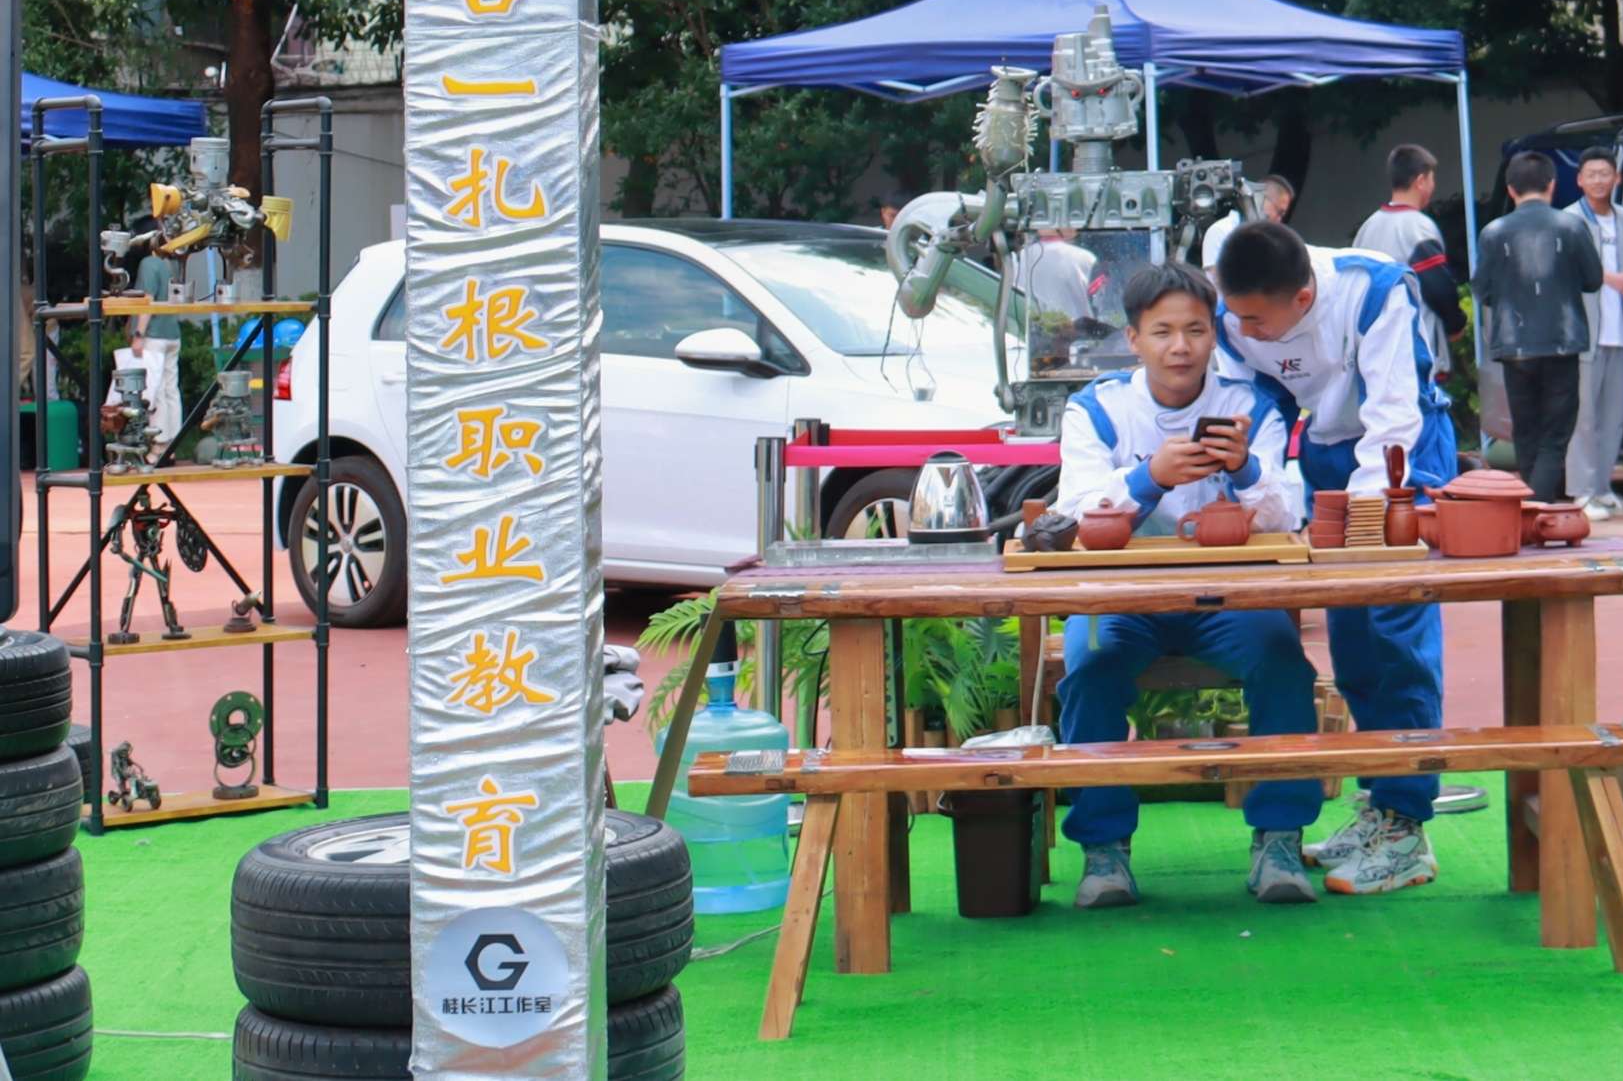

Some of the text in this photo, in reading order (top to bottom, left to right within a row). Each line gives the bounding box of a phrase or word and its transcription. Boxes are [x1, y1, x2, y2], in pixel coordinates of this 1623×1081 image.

[442, 996, 552, 1015] 桂长江工作室
